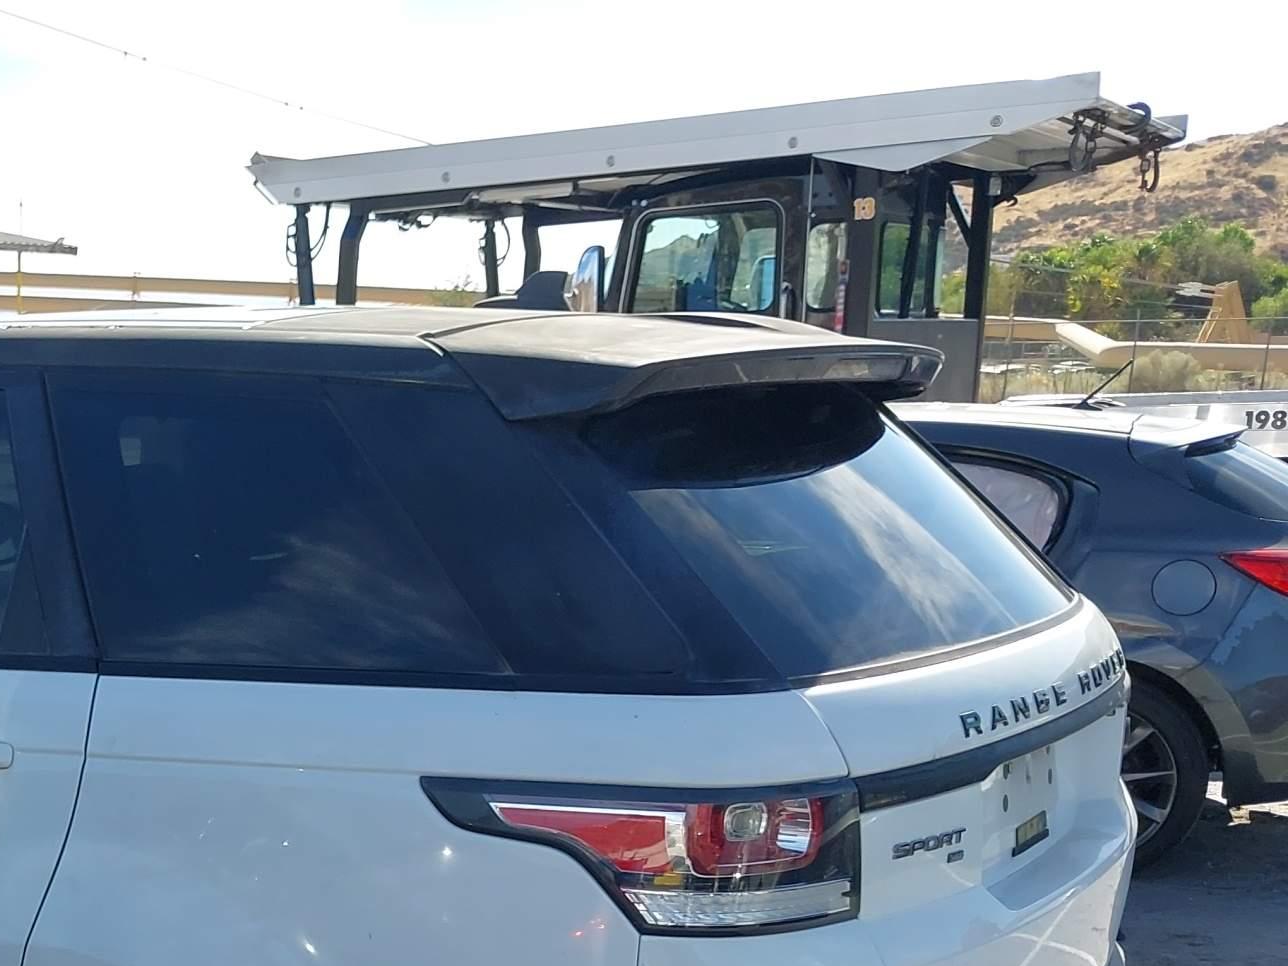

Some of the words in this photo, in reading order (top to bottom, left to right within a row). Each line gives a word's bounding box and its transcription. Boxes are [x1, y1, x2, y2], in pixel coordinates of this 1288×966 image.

[1245, 410, 1288, 430] 198
[959, 680, 1068, 739] RANGE
[891, 827, 967, 861] SPORT
